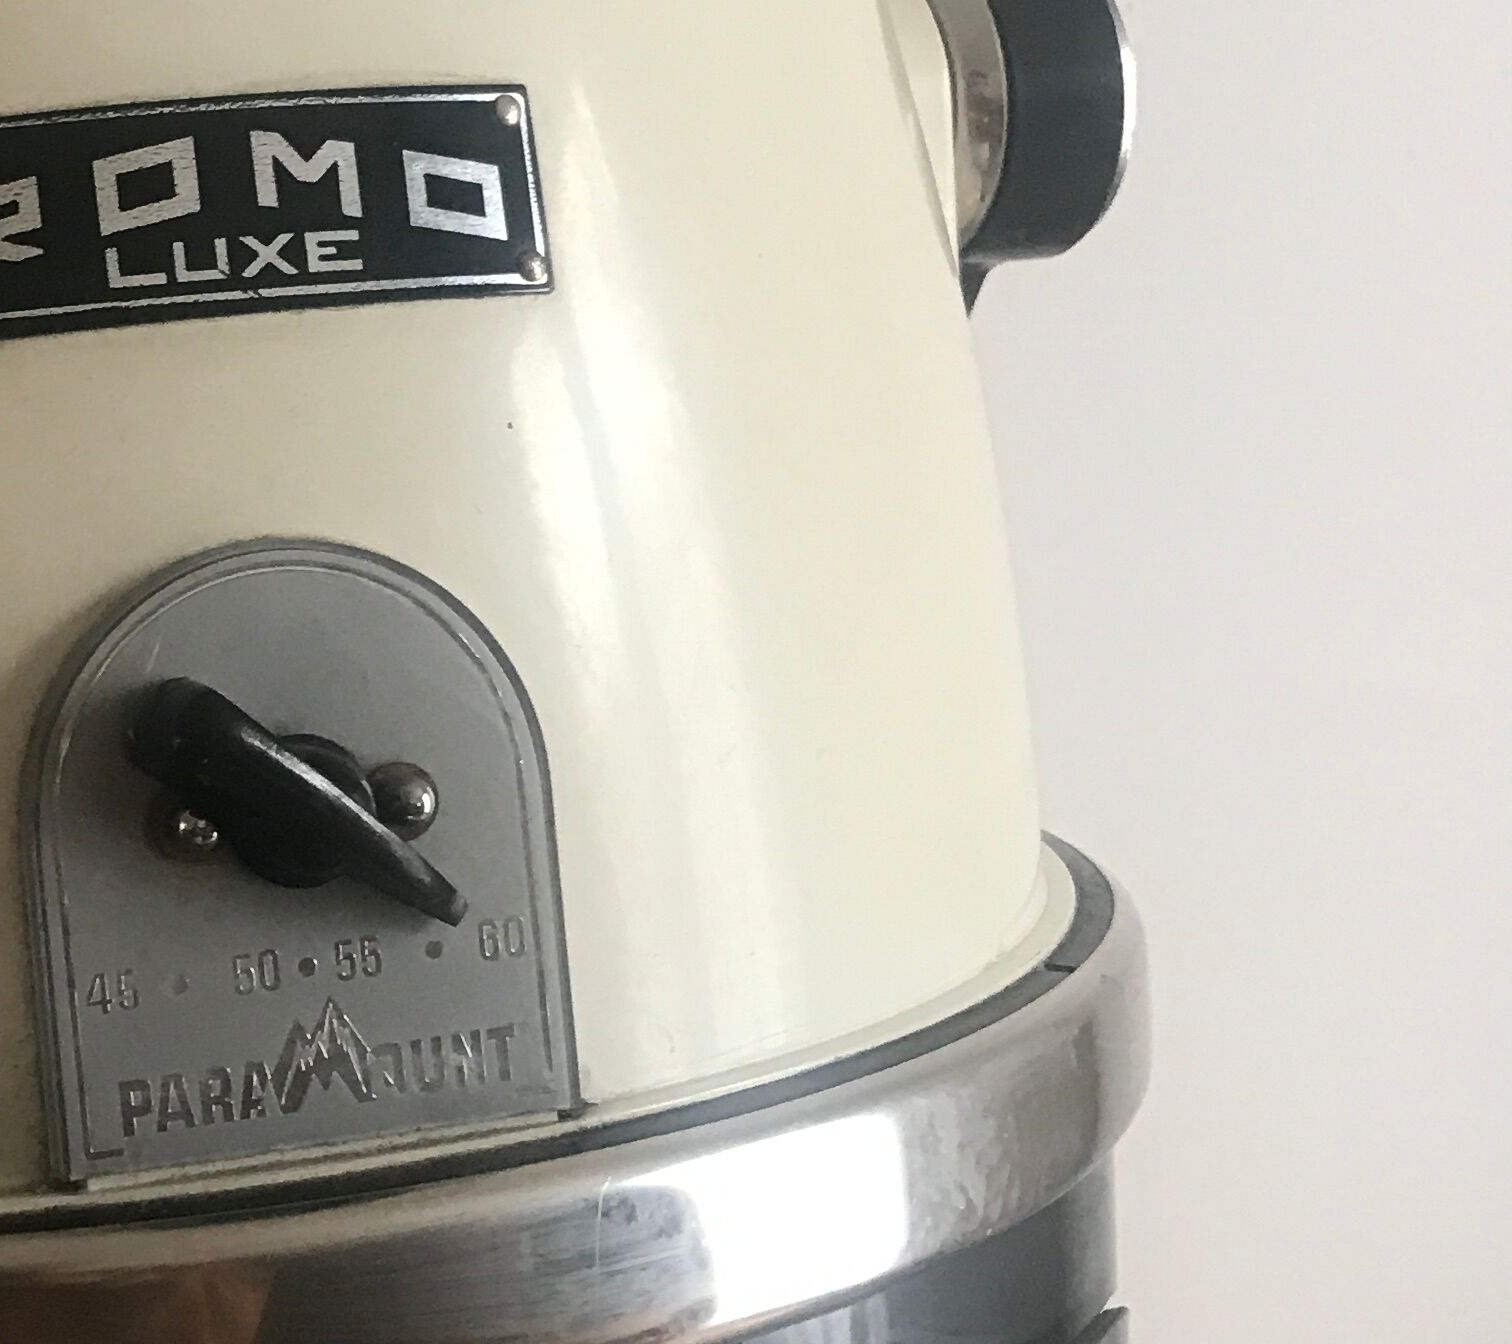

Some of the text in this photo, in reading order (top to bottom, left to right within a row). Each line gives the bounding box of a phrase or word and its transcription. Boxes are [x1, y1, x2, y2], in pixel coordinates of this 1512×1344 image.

[105, 229, 364, 288] LUXE
[88, 916, 526, 1014] 45 50 55 60
[119, 996, 516, 1137] PARAMOUNT
